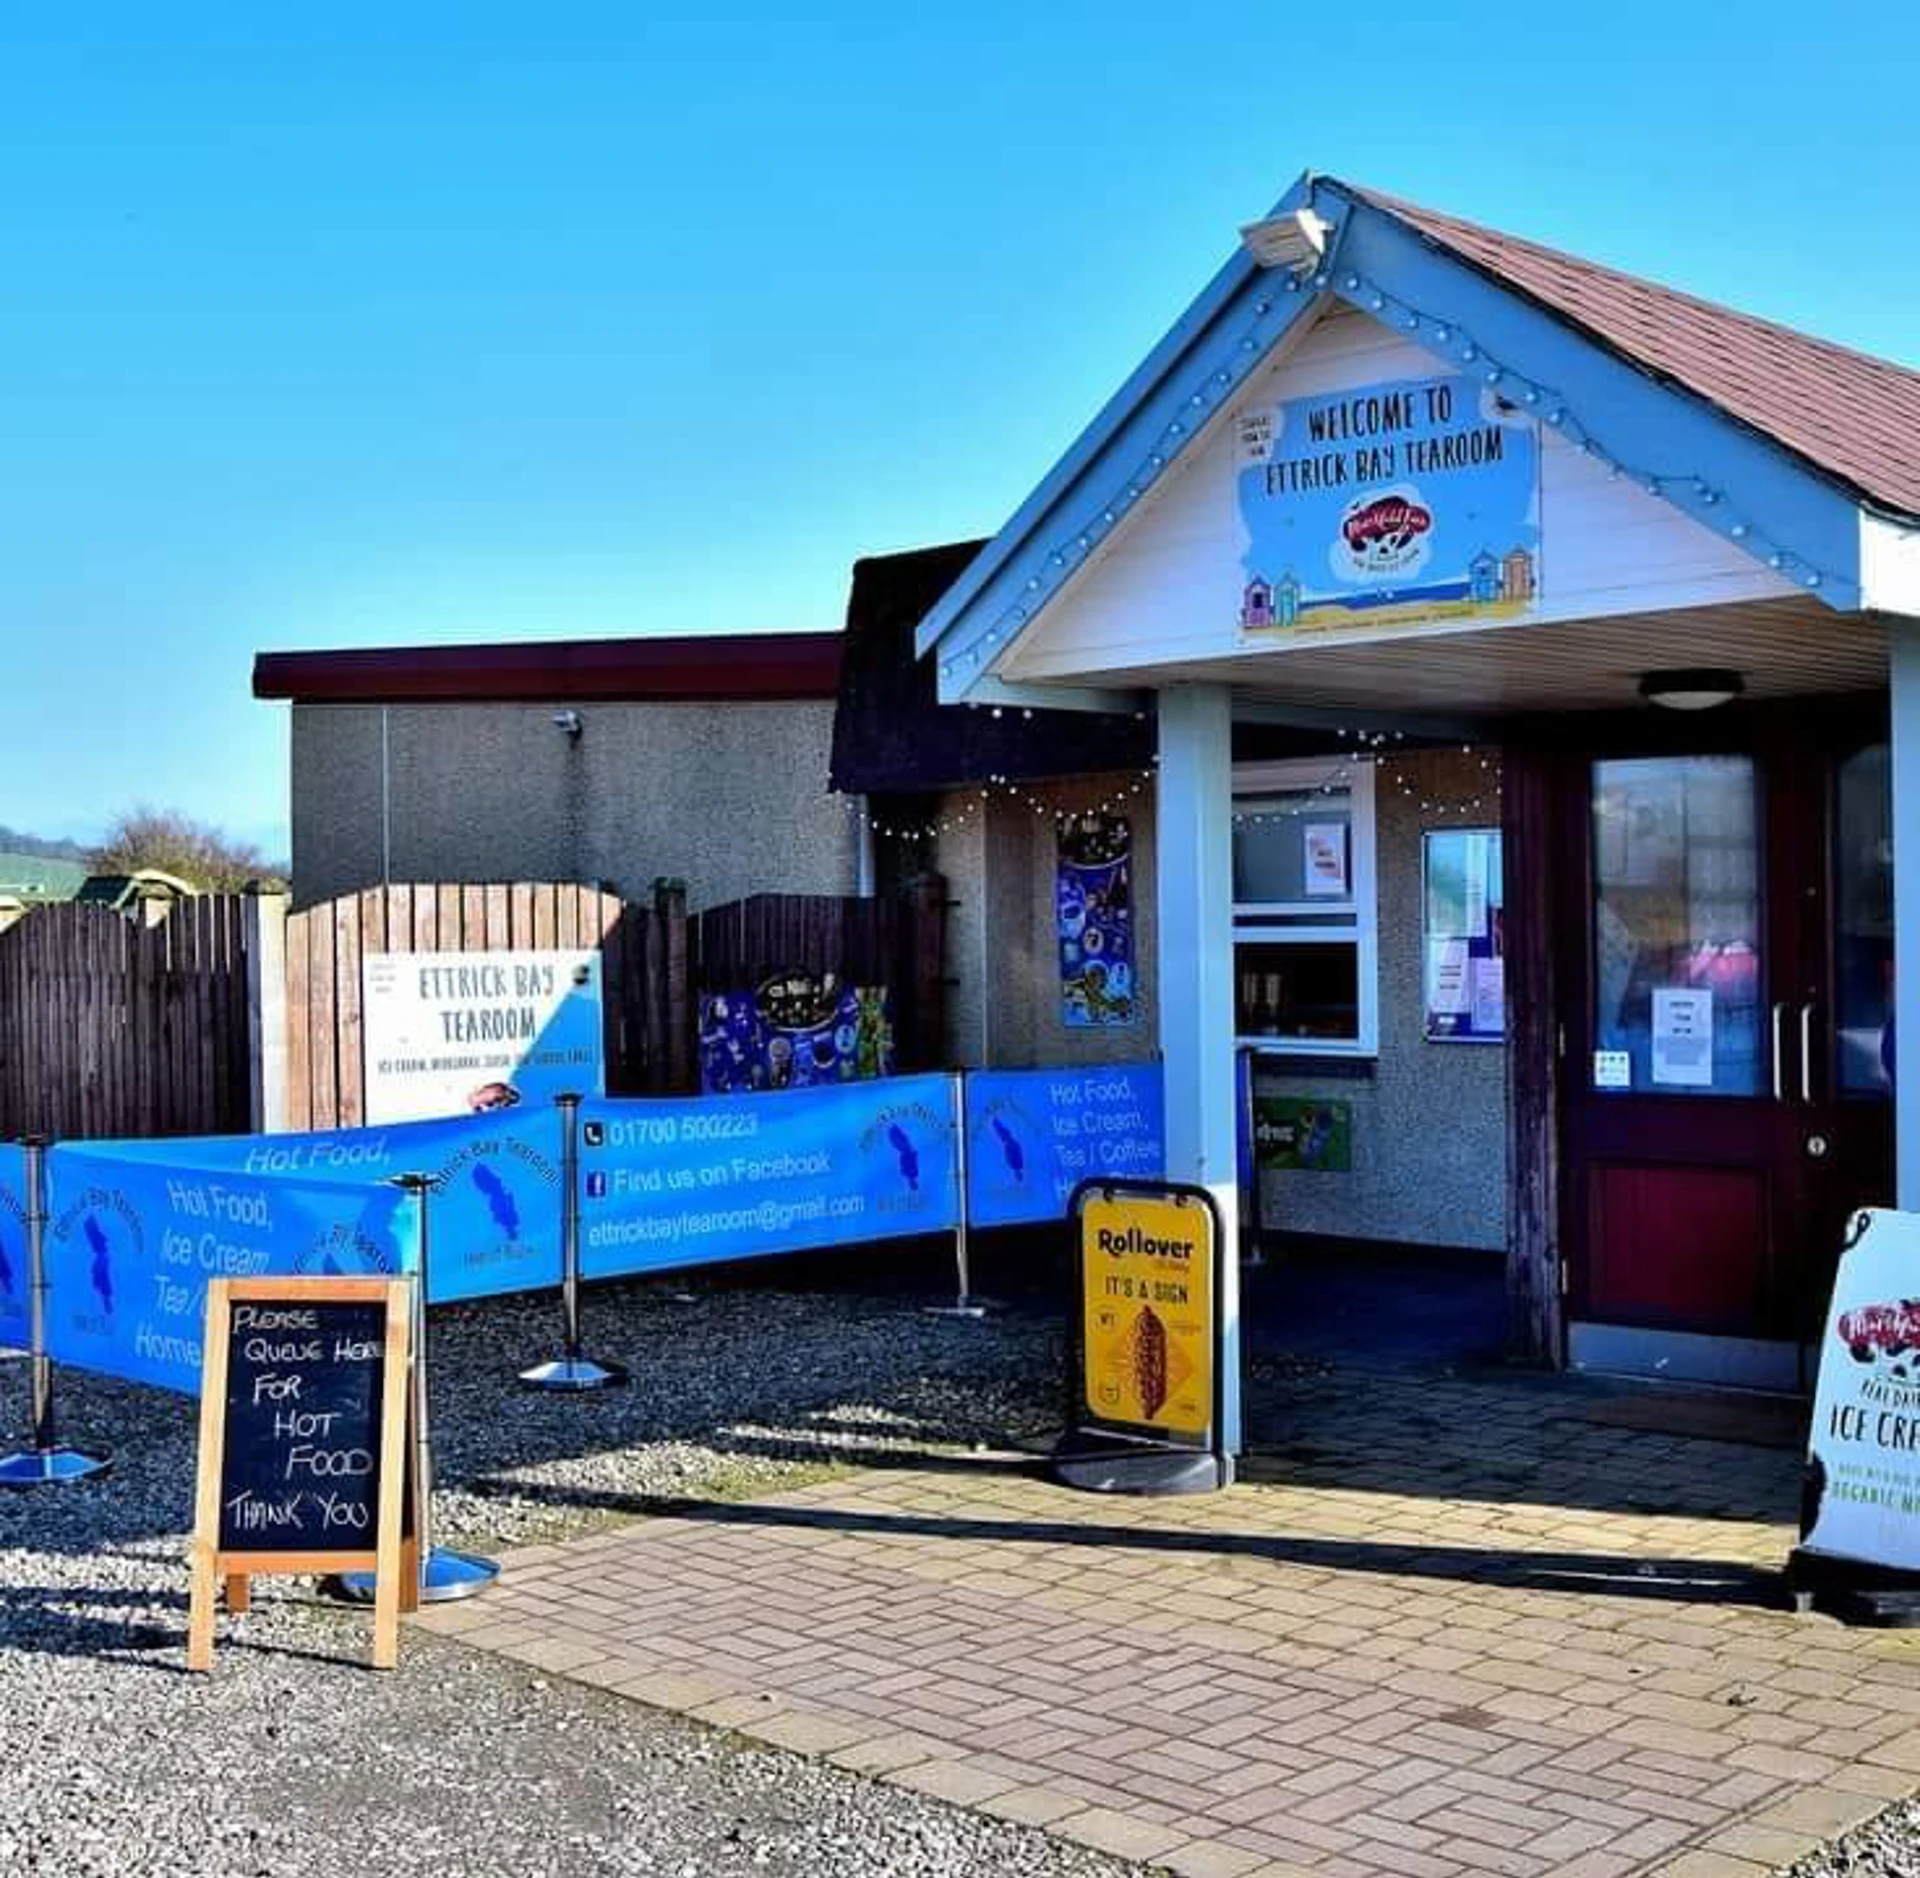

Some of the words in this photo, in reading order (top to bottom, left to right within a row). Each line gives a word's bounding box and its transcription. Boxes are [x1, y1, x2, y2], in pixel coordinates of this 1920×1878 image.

[1308, 393, 1415, 441] WELCOME
[1426, 385, 1451, 424] TO
[1266, 453, 1347, 495] ETTRICK
[1356, 446, 1396, 481] BAY
[1406, 426, 1503, 473] TEAROOM
[419, 966, 508, 999] ETTRICK
[514, 964, 555, 996] BAY
[439, 1007, 536, 1043] TEAROOM
[610, 1118, 678, 1146] 01700
[246, 1145, 298, 1172] Hot
[308, 1136, 390, 1169] Food,
[613, 1168, 660, 1191] Find
[667, 1170, 695, 1188] us
[702, 1164, 728, 1185] on
[733, 1151, 832, 1181] Facebook
[166, 1178, 209, 1218] Hot
[209, 1185, 273, 1232] Food,
[589, 1195, 866, 1248] ettrickbaytearoom@gmail.com
[163, 1226, 192, 1265] Ice
[1098, 1227, 1194, 1258] Rollover
[154, 1274, 189, 1315] Tea
[1138, 1280, 1149, 1299] A
[1155, 1281, 1188, 1304] SIGN
[233, 1306, 317, 1334] PLEASE
[245, 1340, 322, 1363] QUEUE
[253, 1372, 302, 1406] FOR
[274, 1409, 342, 1439] HOT
[1829, 1402, 1868, 1442] ICE
[285, 1445, 373, 1480] FOOD
[226, 1489, 303, 1530] THANK
[313, 1491, 369, 1530] YOU
